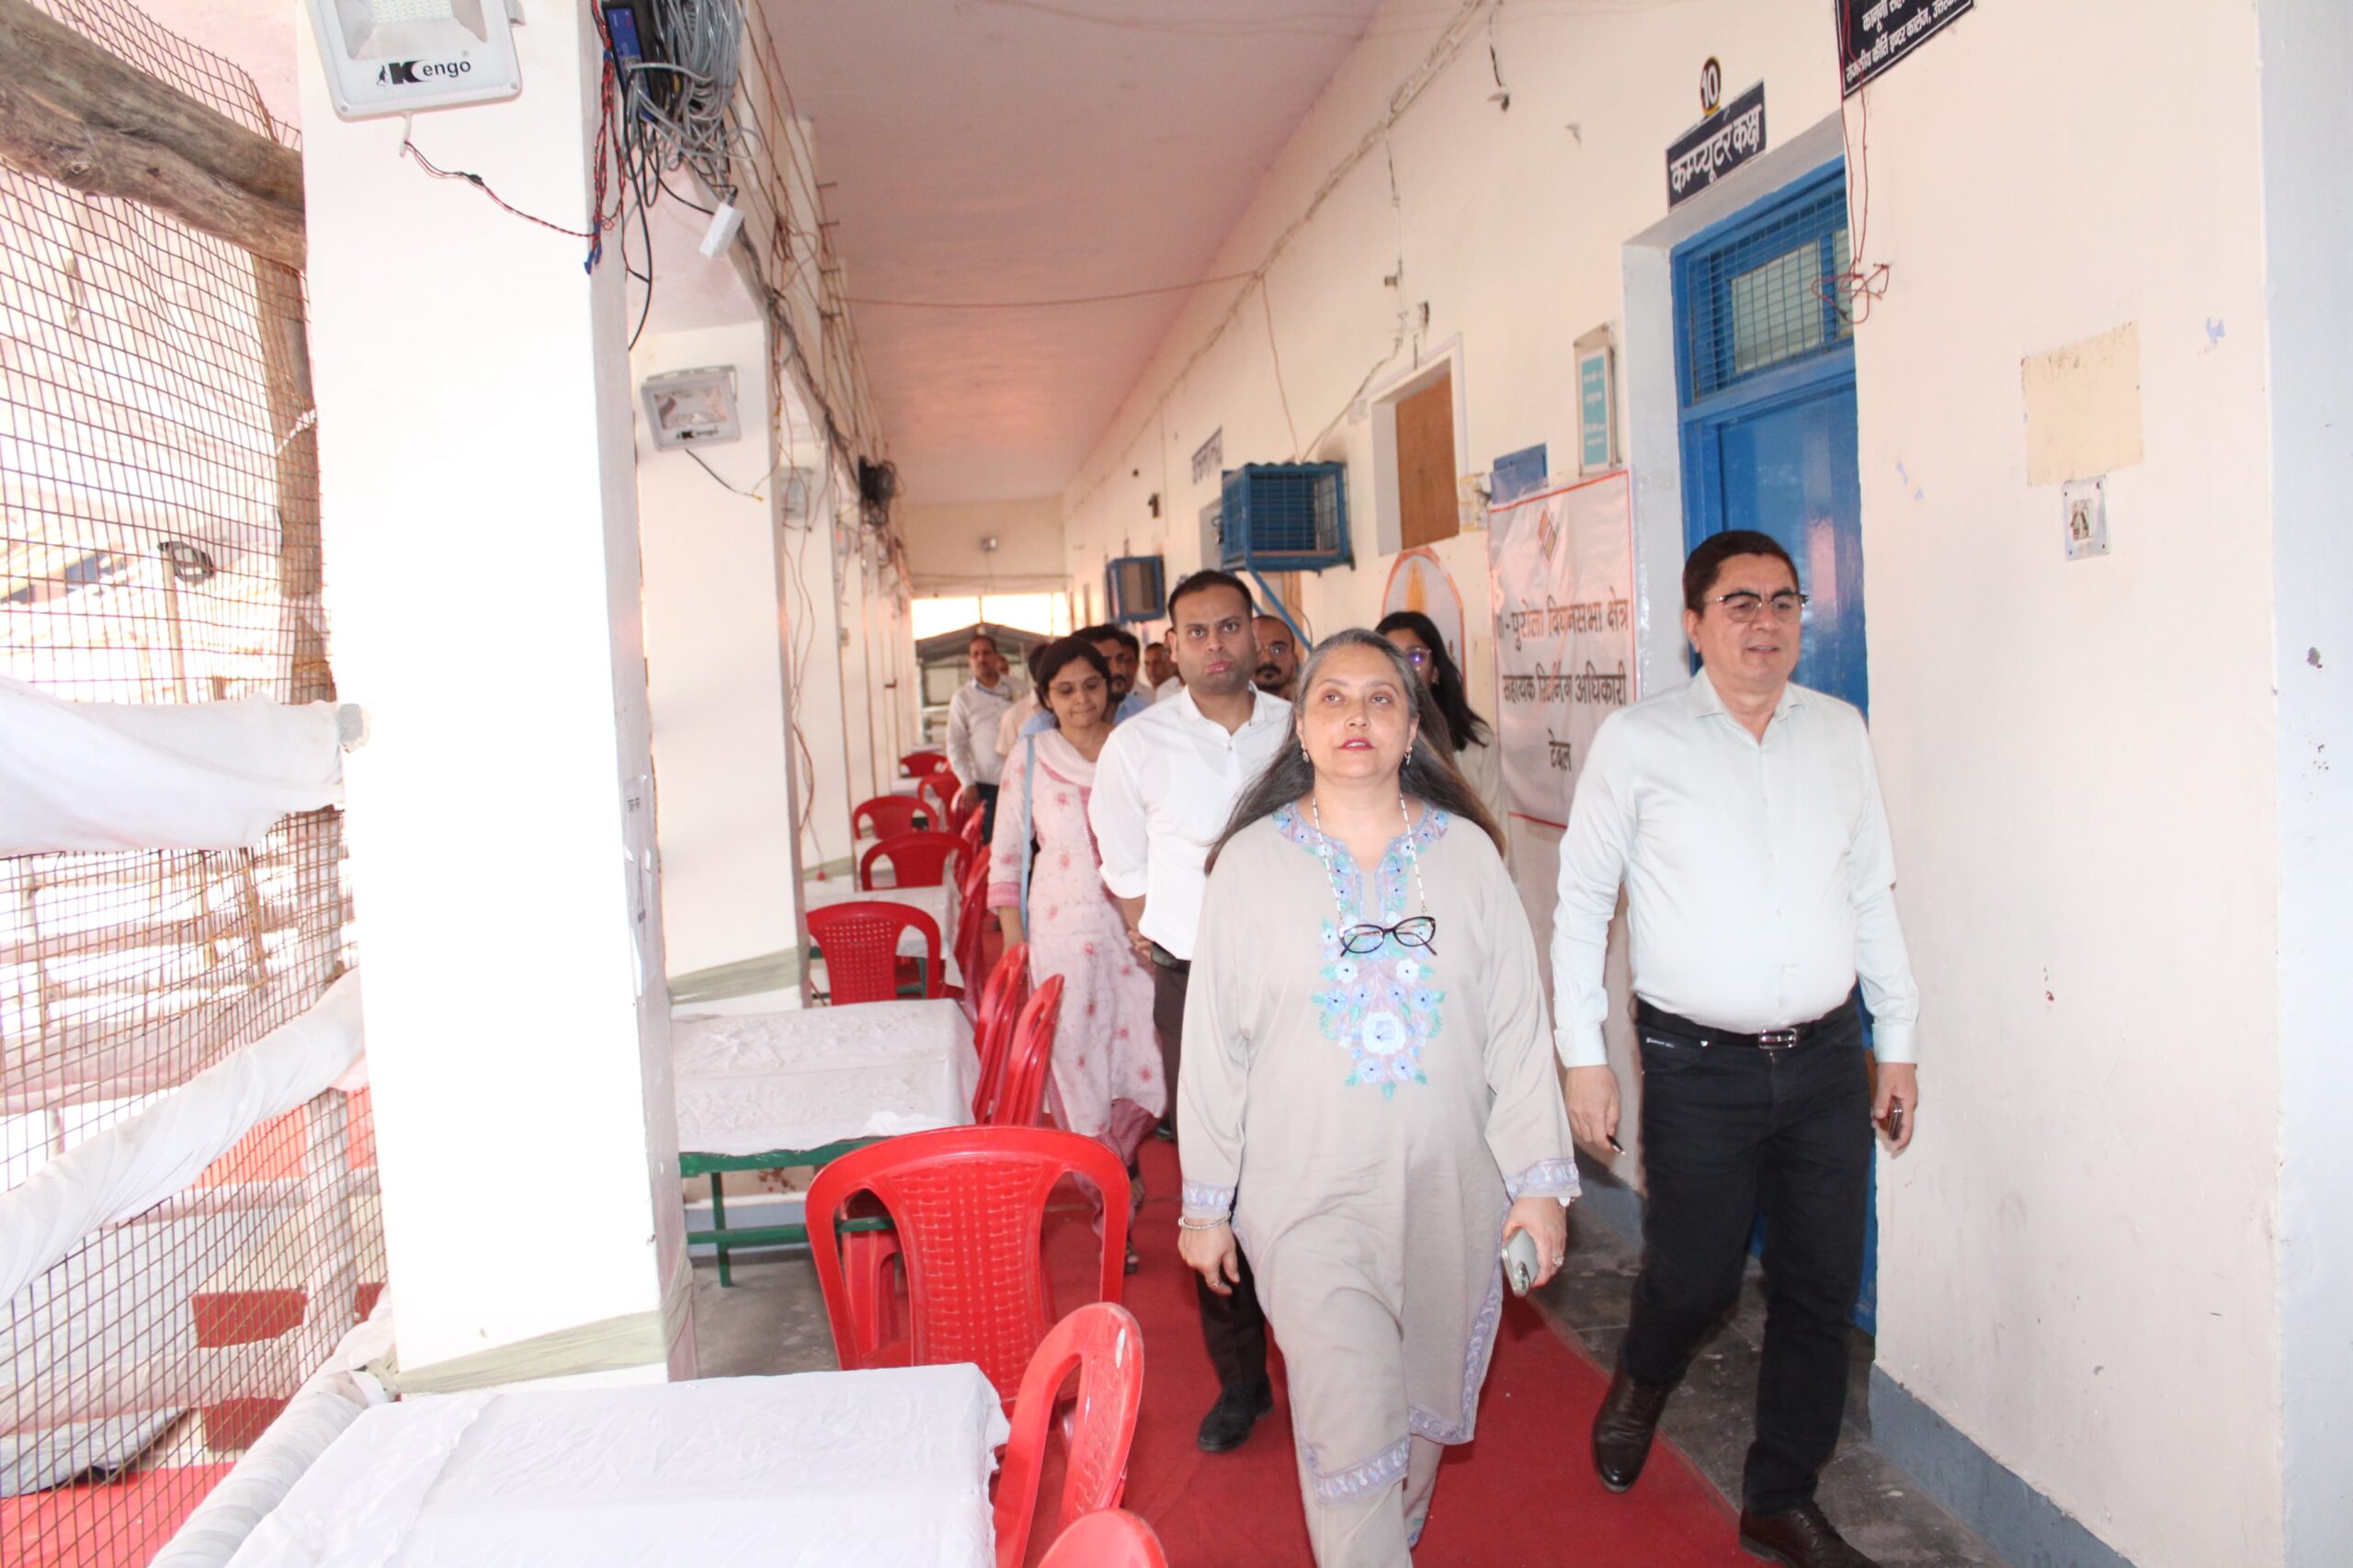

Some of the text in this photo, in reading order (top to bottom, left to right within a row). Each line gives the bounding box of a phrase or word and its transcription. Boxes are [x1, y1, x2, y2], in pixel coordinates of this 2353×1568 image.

[389, 59, 471, 85] Kengo
[1701, 64, 1719, 108] 10
[1670, 104, 1762, 193] कम्प्यूटर कक्ष
[1607, 586, 1629, 632] क्षेत्र
[1503, 674, 1536, 703] सहायक
[1574, 660, 1627, 706] अधिकारी
[1548, 728, 1572, 772] टेबल
